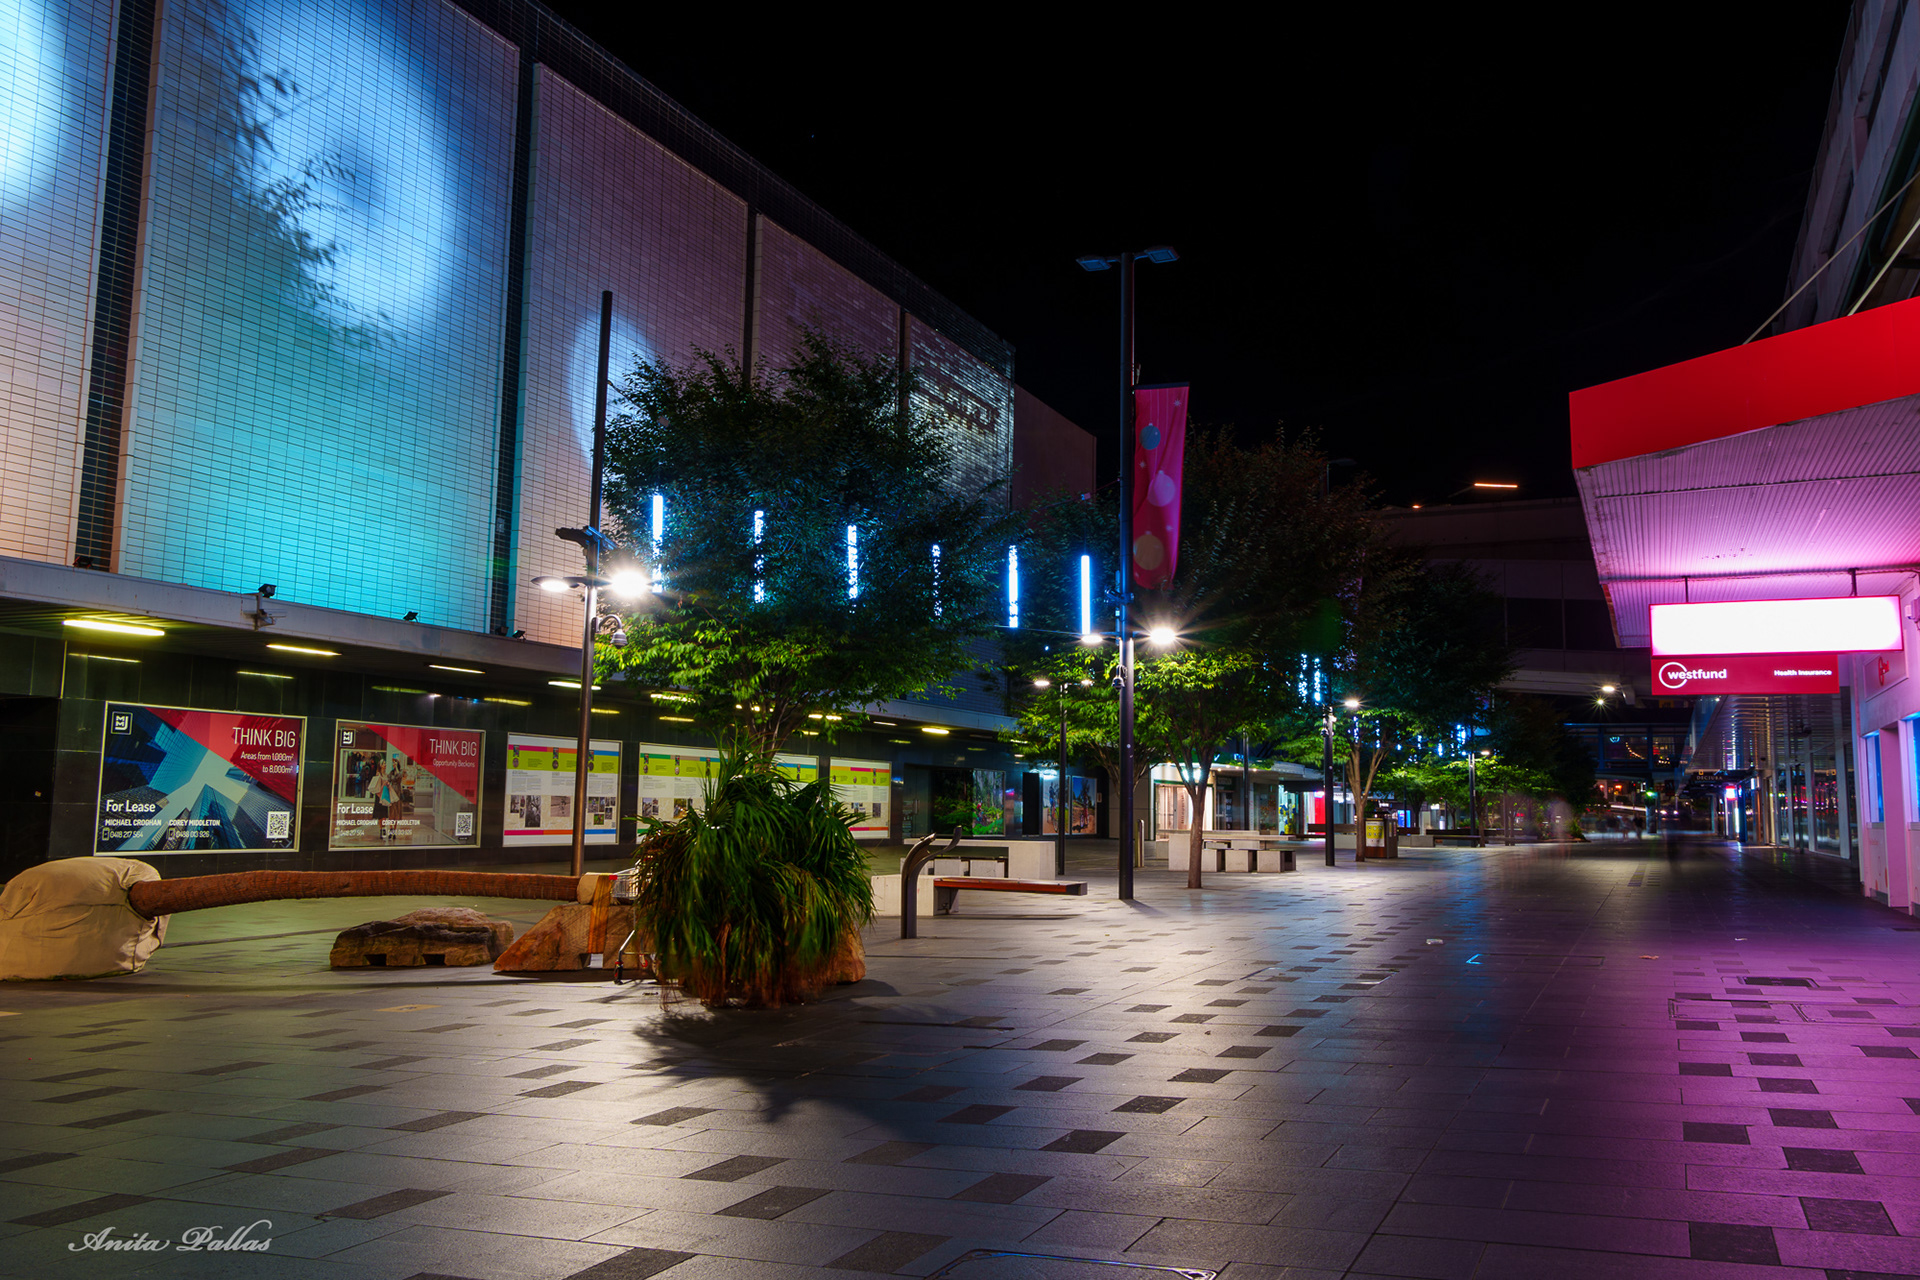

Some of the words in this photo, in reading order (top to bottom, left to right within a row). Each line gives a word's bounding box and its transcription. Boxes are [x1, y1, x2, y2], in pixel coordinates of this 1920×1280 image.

[1667, 668, 1727, 680] westfund
[232, 726, 272, 747] THINK
[275, 729, 296, 748] BIG
[429, 738, 459, 755] THINK
[461, 740, 477, 757] BIG
[240, 751, 257, 761] Areas
[257, 751, 271, 761] from
[262, 764, 269, 773] to
[432, 758, 457, 769] Opportunity
[106, 799, 124, 812] For
[125, 799, 156, 813] Lease
[336, 803, 350, 814] For
[351, 803, 374, 814] Lease
[188, 819, 221, 827] MIDDLETON
